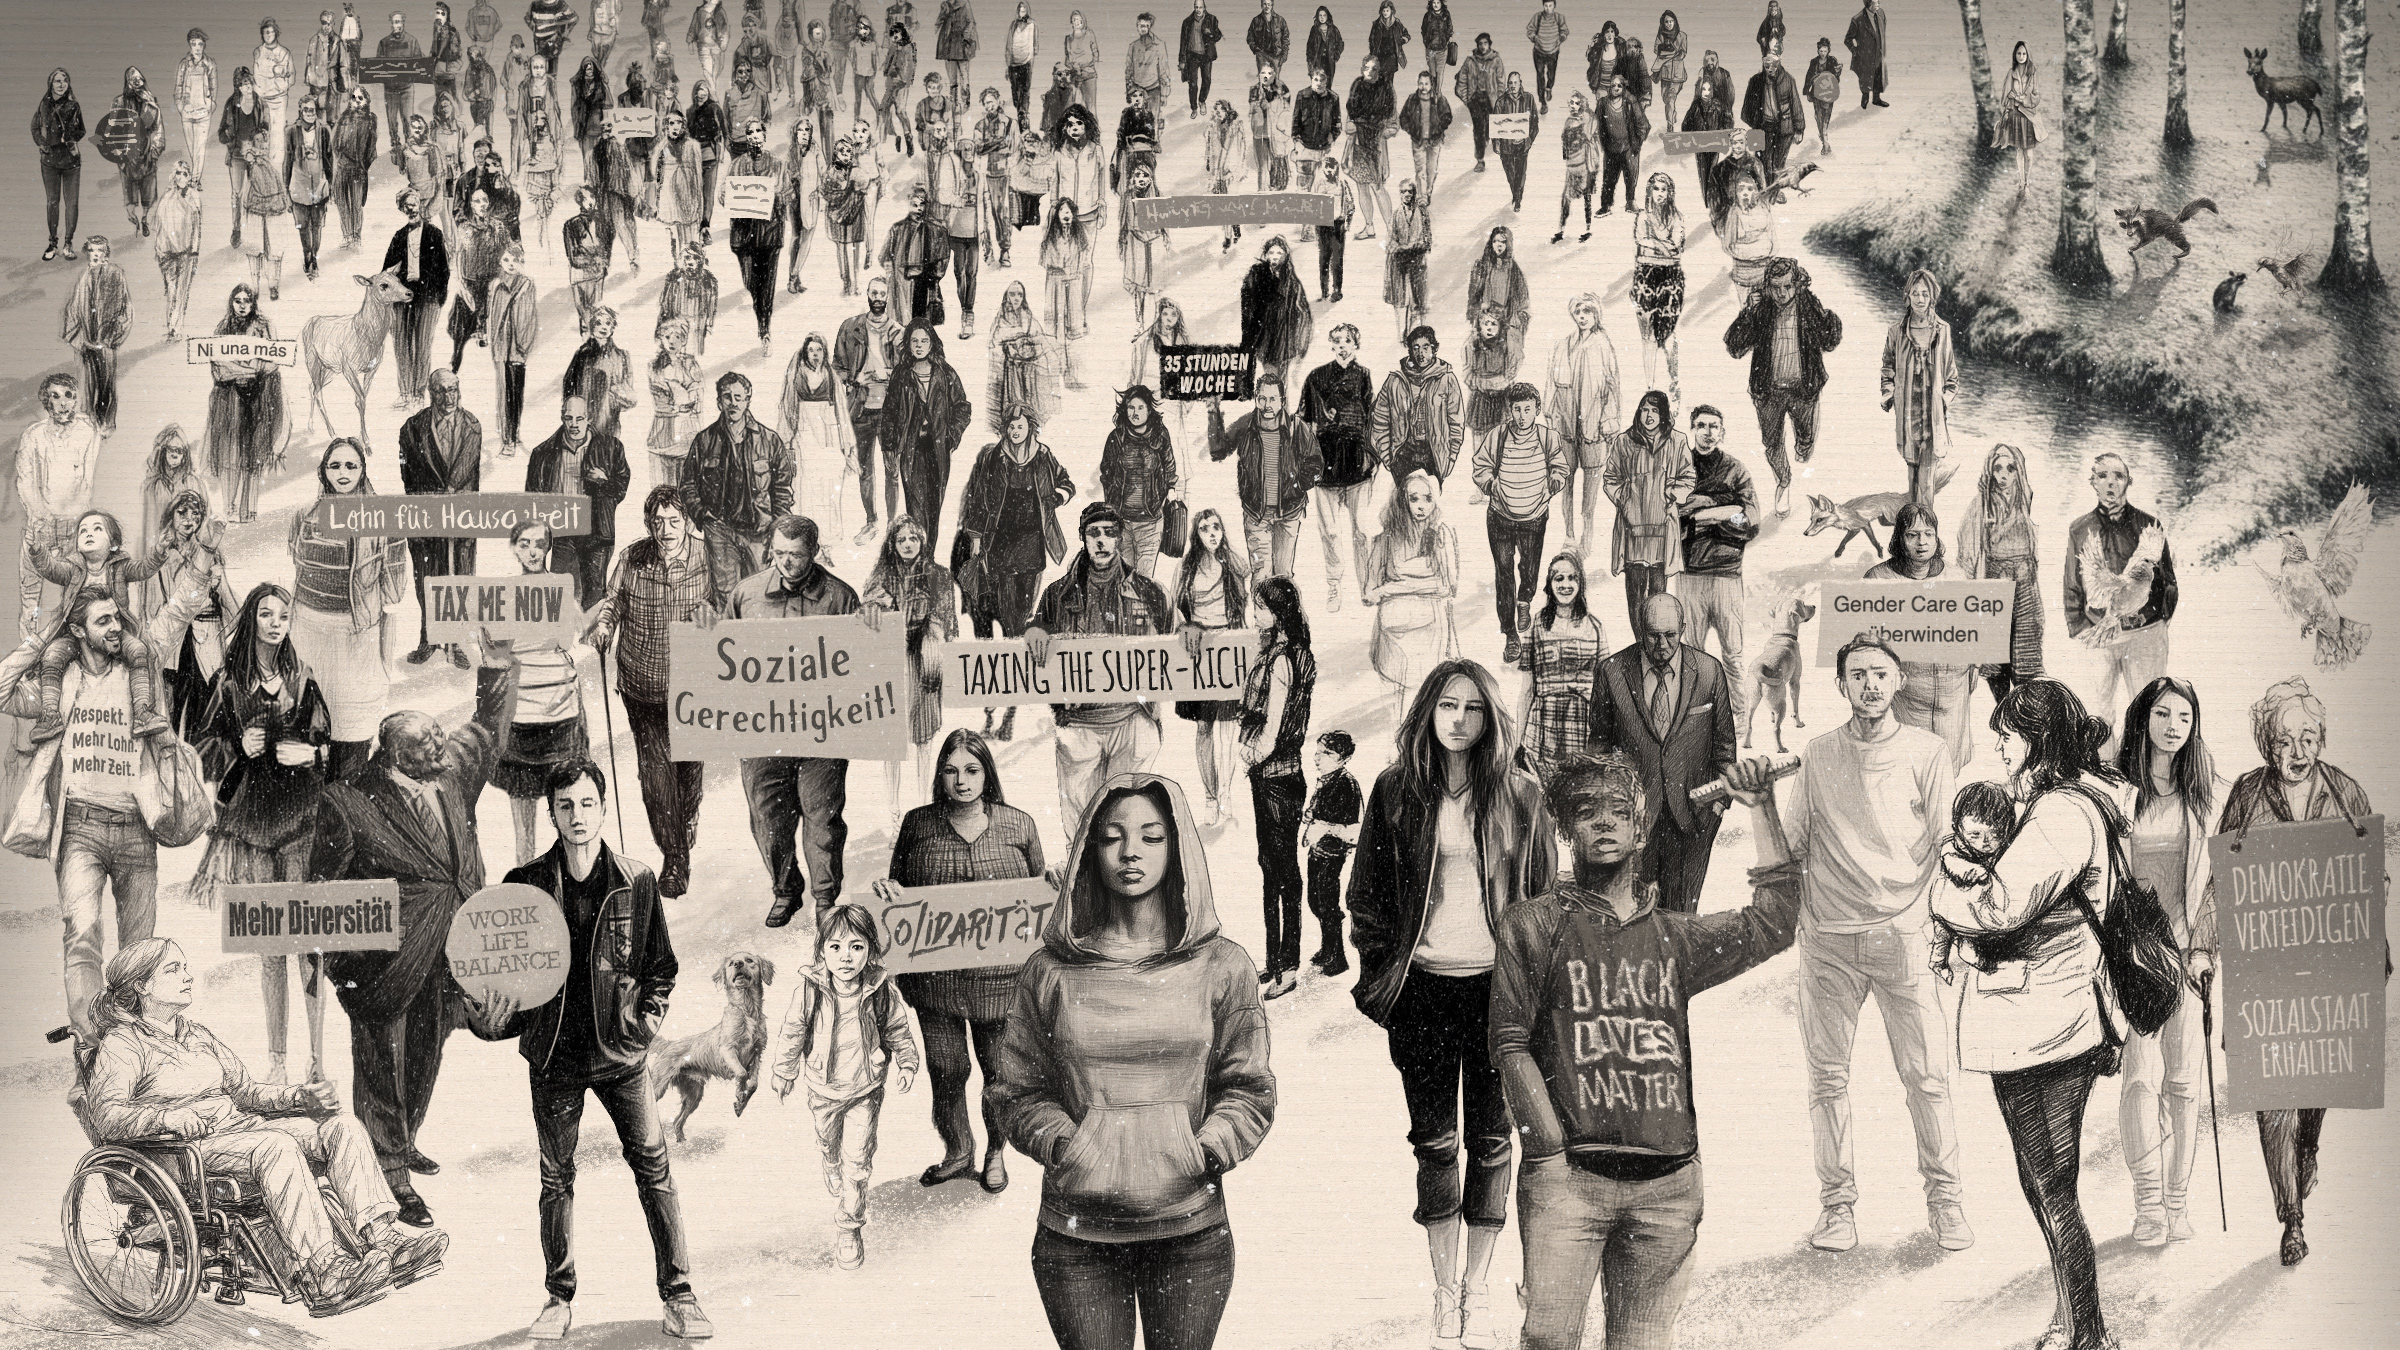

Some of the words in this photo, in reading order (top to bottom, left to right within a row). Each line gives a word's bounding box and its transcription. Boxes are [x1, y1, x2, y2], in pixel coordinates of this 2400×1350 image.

[197, 343, 213, 357] Ni
[220, 344, 250, 355] una
[254, 342, 287, 357] más
[1164, 354, 1182, 373] 35
[1184, 352, 1249, 373] STUNDEN
[1180, 374, 1236, 394] WOCHE
[329, 502, 385, 530] Lohn
[394, 504, 434, 530] für
[431, 585, 470, 622] TAX
[478, 585, 506, 622] ME
[515, 585, 564, 623] NOW
[1833, 595, 1905, 613] Gender
[1911, 595, 1958, 613] Care
[1963, 595, 2004, 617] Gap
[717, 636, 850, 683] Soziale
[958, 650, 1051, 696] TAXING
[1056, 650, 1096, 693] THE
[72, 707, 128, 726] Respekt.
[675, 681, 896, 743] Gerechtigkeit!
[72, 731, 106, 750] Mehr
[107, 732, 138, 753] Lohn.
[72, 755, 107, 774] Mehr
[107, 757, 136, 777] Zeit.
[2232, 853, 2374, 907] DEMOKRATIE
[229, 901, 284, 937] Mehr
[288, 896, 393, 936] Diversität
[466, 905, 540, 930] WORK
[2234, 899, 2371, 952] VERTEIDIGEN
[480, 930, 529, 952] LIFE
[453, 950, 561, 979] BALANCE
[1566, 957, 1677, 1014] BLACK
[2241, 992, 2371, 1039] SOZIALSTAAT
[1574, 1014, 1683, 1068] LIVES
[2261, 1036, 2354, 1078] ERHALTEN
[1577, 1067, 1683, 1113] MATTER
